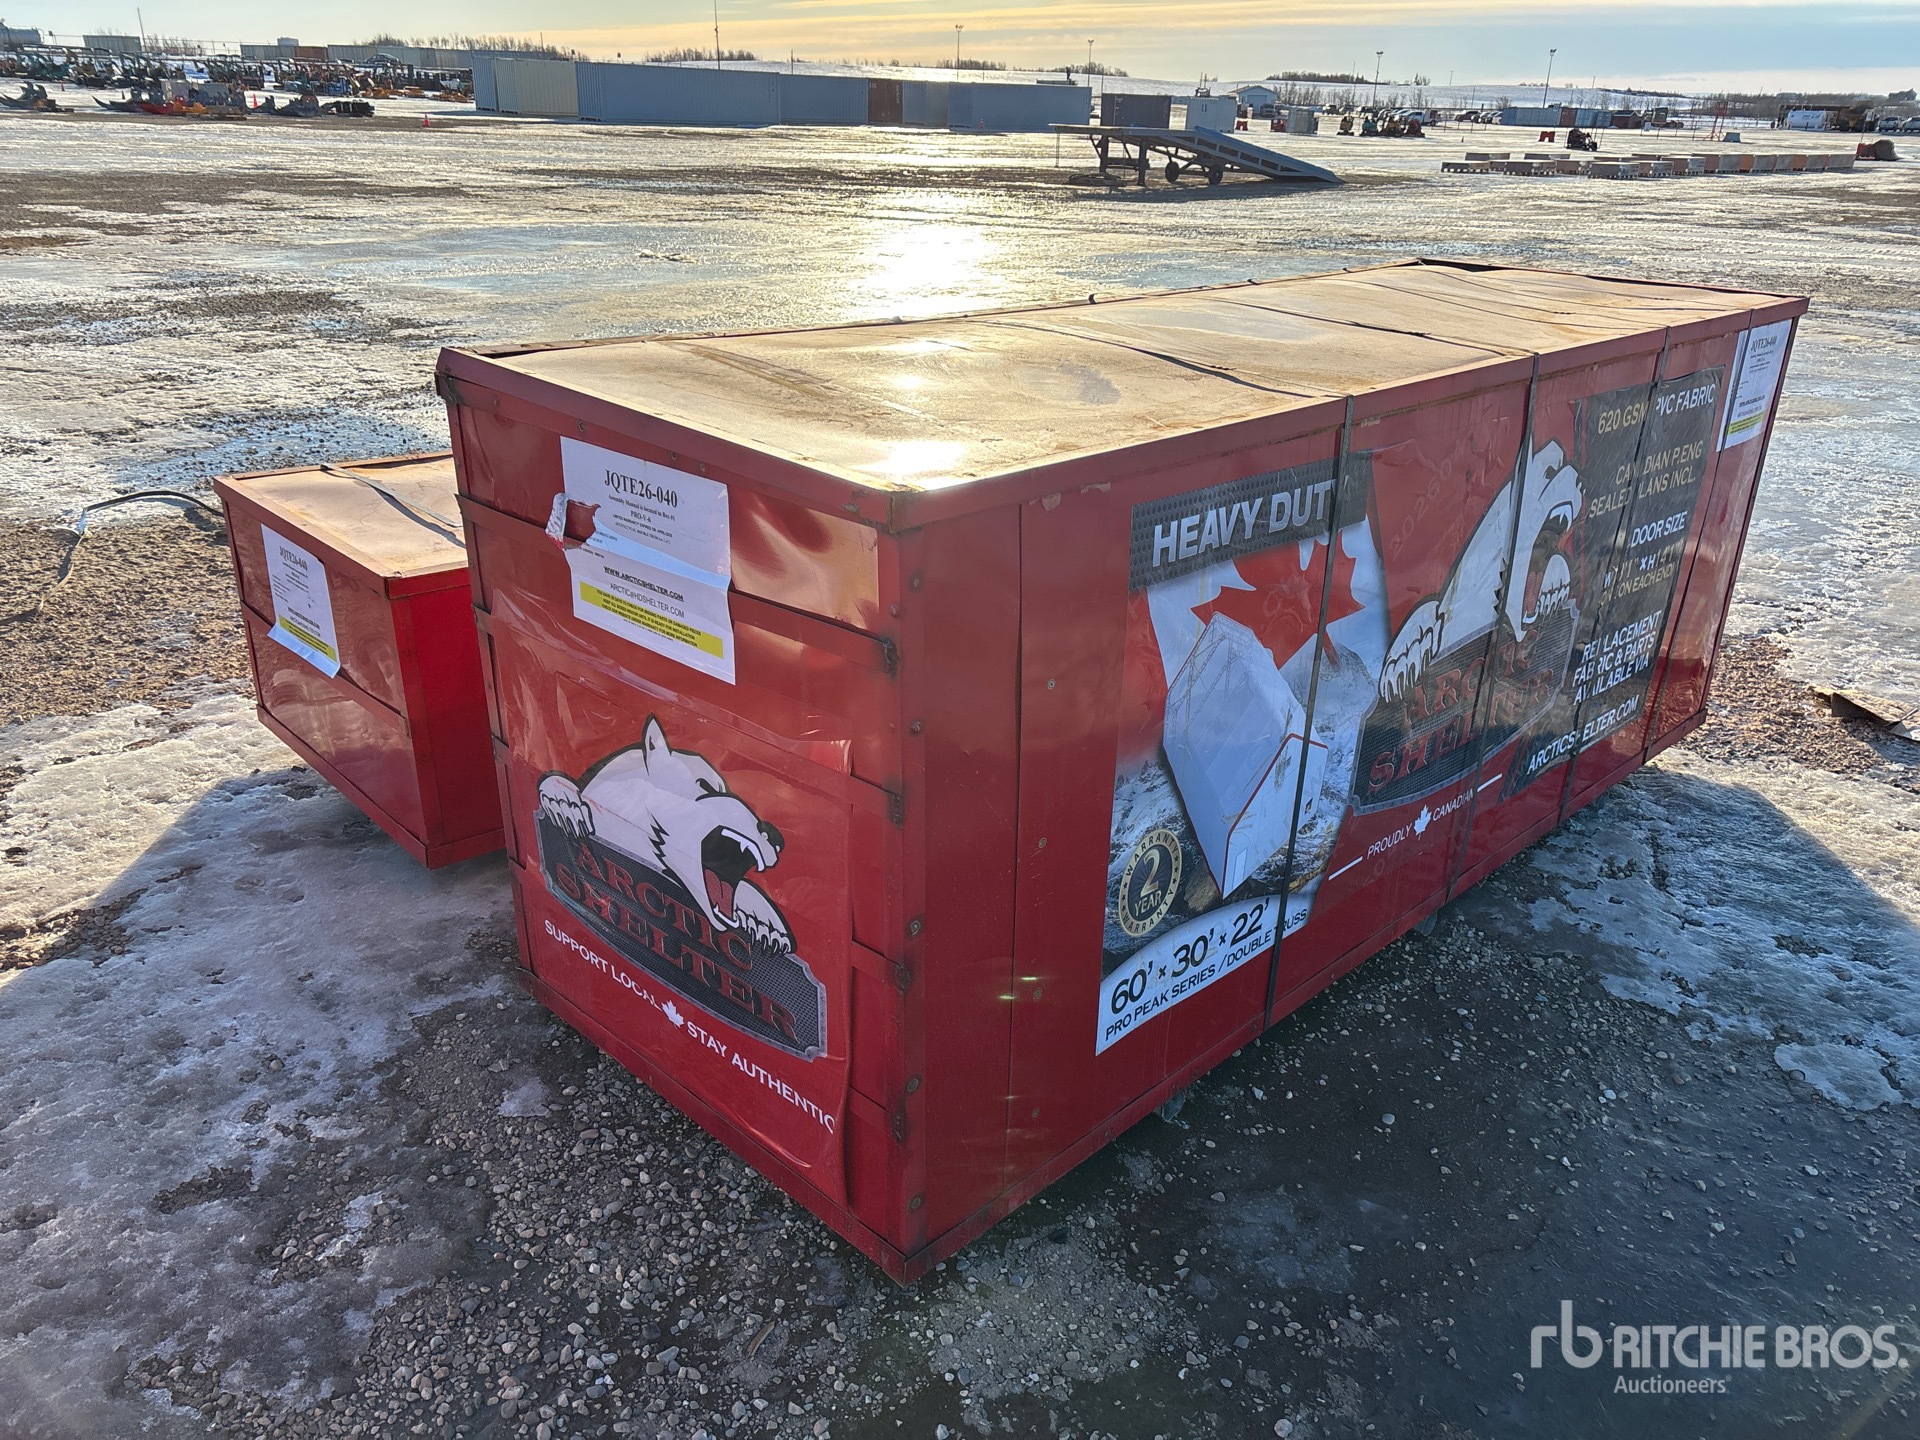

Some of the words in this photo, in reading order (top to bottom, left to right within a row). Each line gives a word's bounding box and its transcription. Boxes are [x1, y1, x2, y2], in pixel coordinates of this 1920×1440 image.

[1598, 408, 1620, 434] 620
[1675, 383, 1716, 412] FABRIC
[1671, 440, 1703, 466] P.ENG
[604, 469, 678, 508] JQTE26-040
[1638, 473, 1669, 499] LANS
[1669, 466, 1696, 489] INCL.
[1152, 497, 1264, 567] HEAVY
[1631, 519, 1664, 548] DOOR
[1663, 511, 1687, 536] SIZE
[1632, 569, 1658, 592] EACH
[1613, 648, 1624, 667] &
[1623, 631, 1656, 662] PARTS
[1634, 651, 1650, 674] VIA
[1366, 823, 1413, 860] PROUDLY
[1432, 786, 1474, 822] CANADIAN
[1126, 832, 1179, 877] WARRANTY
[1141, 848, 1160, 898] 2
[576, 842, 753, 972] ARCTIC
[1123, 888, 1175, 934] WARRANTY
[1134, 890, 1162, 917] YEAR
[556, 862, 801, 1045] SHELTER
[544, 919, 608, 975] SUPPORT
[610, 963, 662, 1013] LOCAL
[686, 1020, 727, 1060] STAY
[1105, 1013, 1132, 1041] PRO
[1134, 990, 1169, 1021] PEAK
[1171, 964, 1216, 998] SERIES
